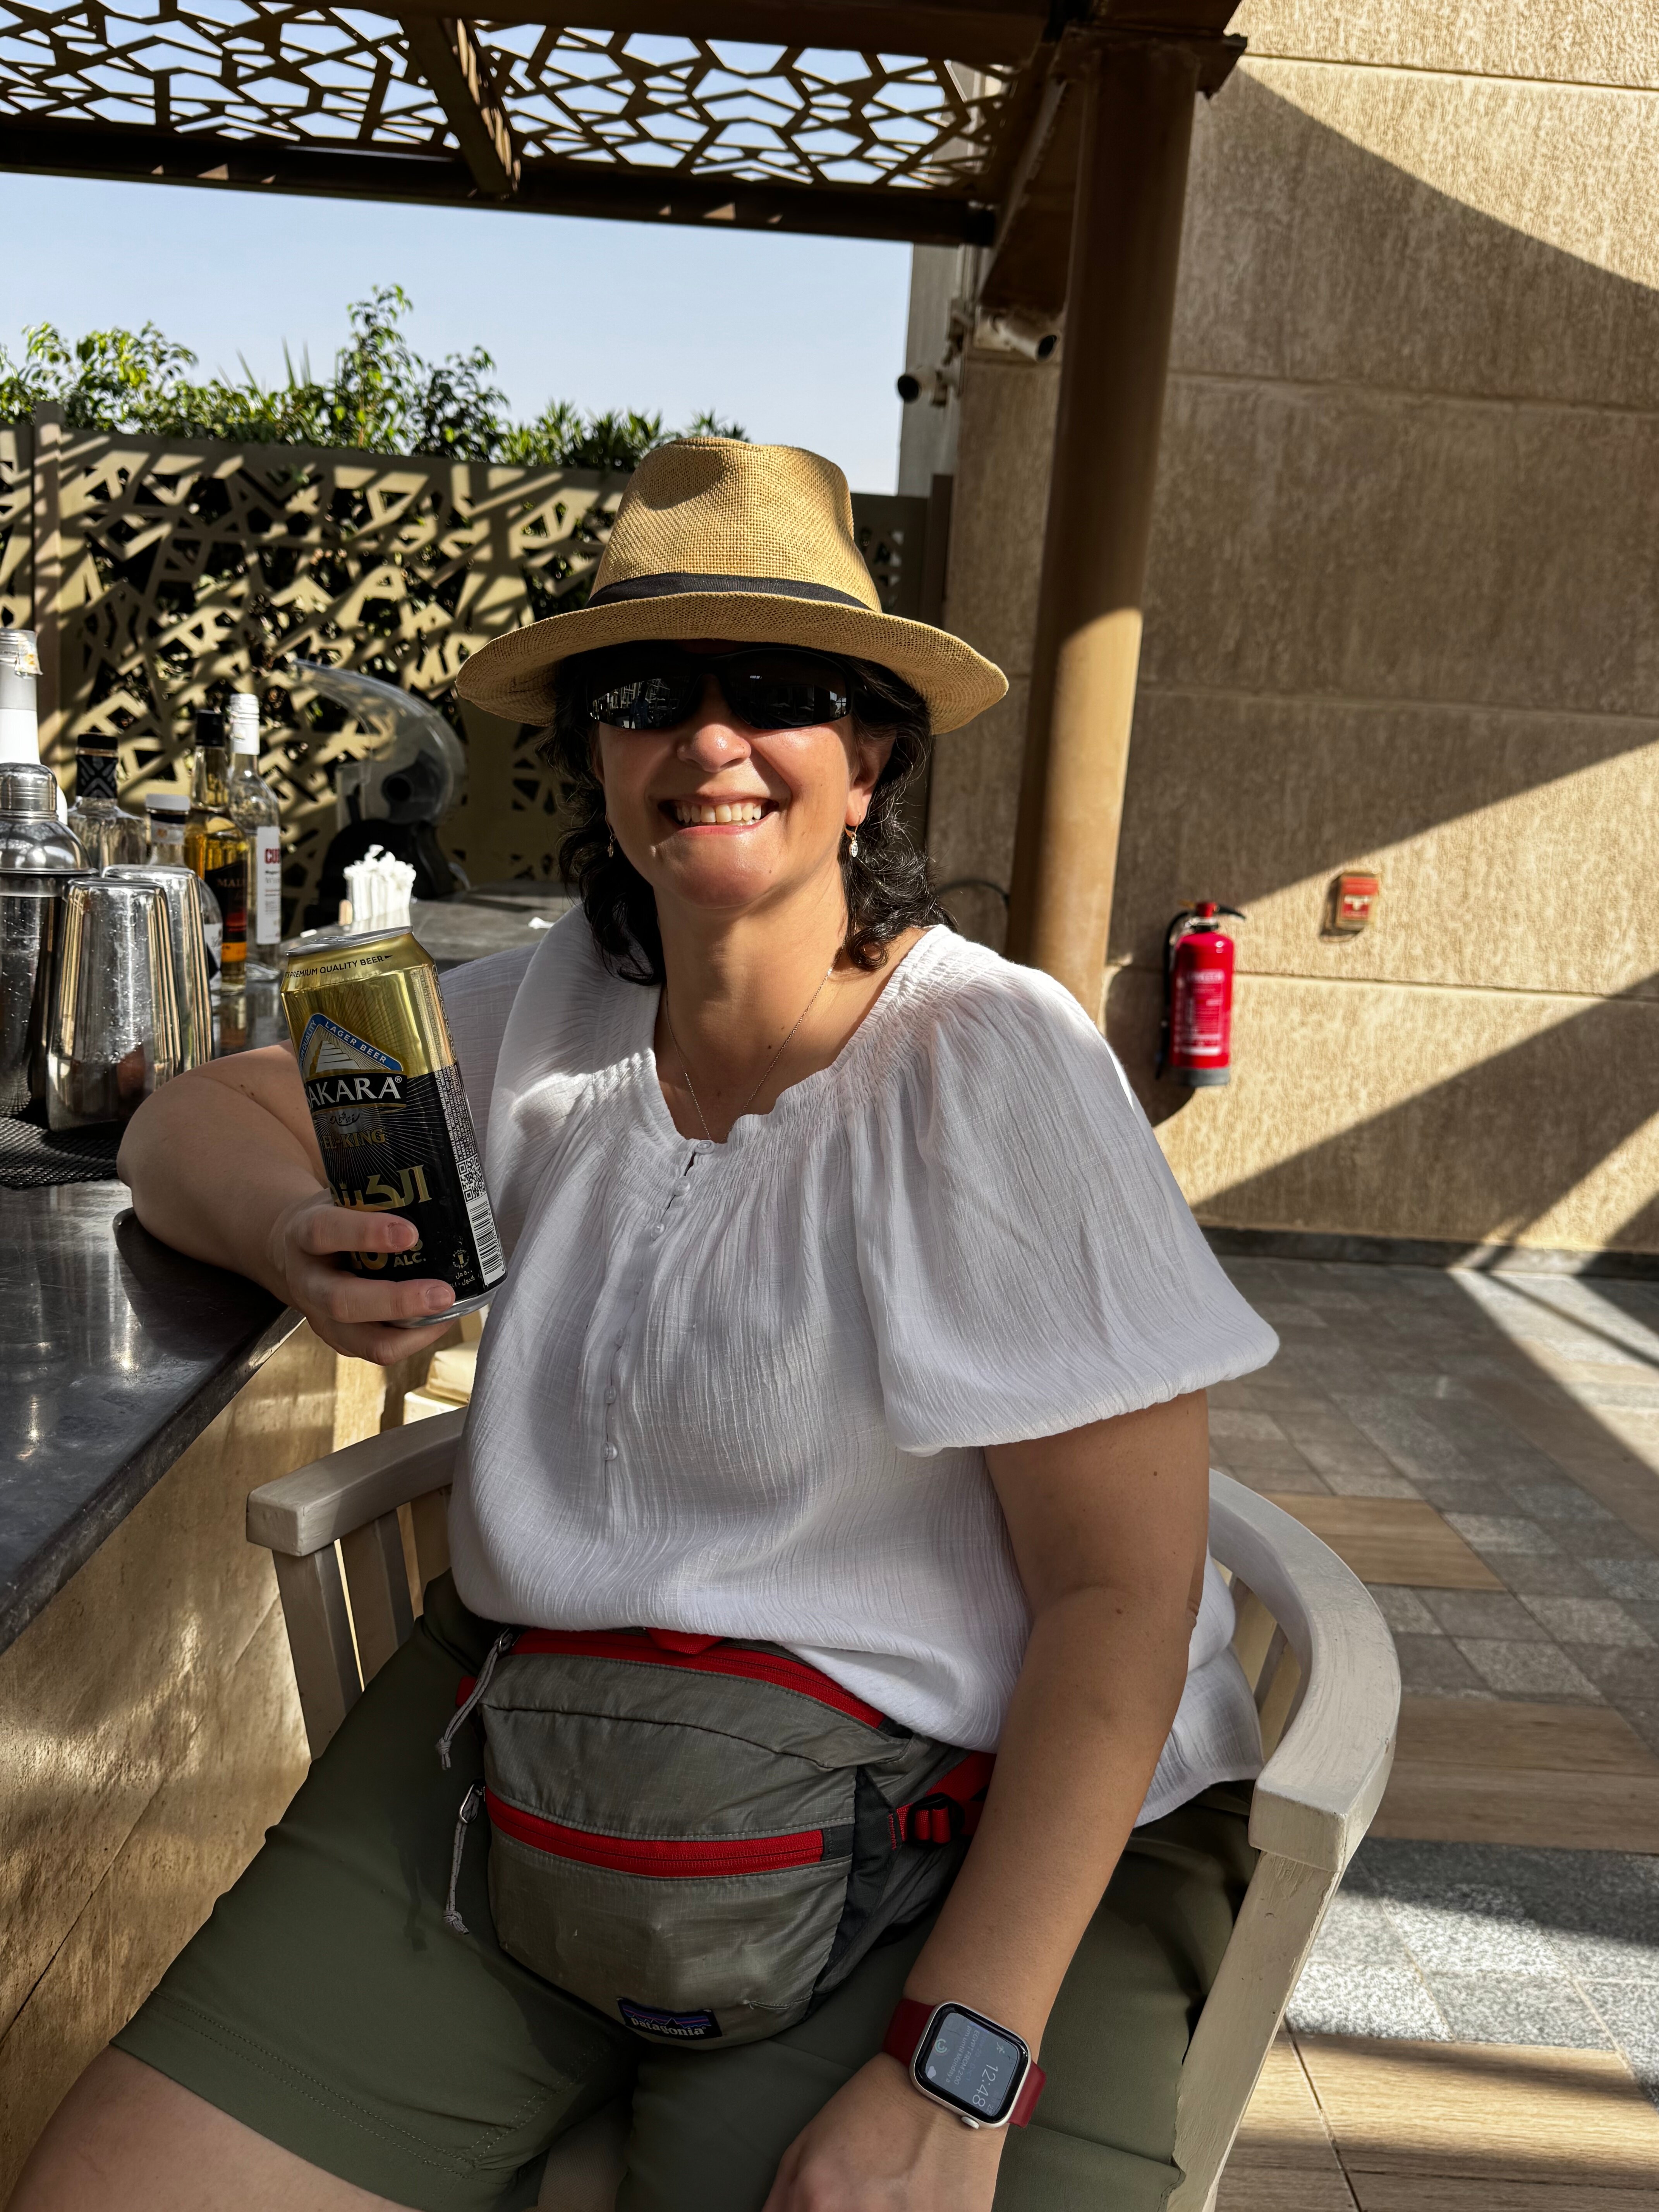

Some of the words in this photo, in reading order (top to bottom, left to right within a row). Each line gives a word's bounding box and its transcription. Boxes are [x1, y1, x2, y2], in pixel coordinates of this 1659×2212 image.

[290, 968, 318, 978] PREMIUM
[320, 960, 357, 974] QUALITY
[360, 955, 383, 966] BEER
[302, 1020, 316, 1050] QUALITY
[325, 1021, 357, 1046] LAGER
[359, 1044, 387, 1063] BEER
[307, 1077, 401, 1109] AKARA
[322, 1128, 385, 1149] EL-KING
[394, 1252, 426, 1267] ALC.
[630, 2017, 704, 2036] patagonia
[965, 2025, 972, 2037] pm
[958, 2037, 967, 2053] until
[968, 2030, 980, 2051] EGYPT
[947, 2052, 962, 2078] Monday
[961, 2051, 972, 2070] FROM
[972, 2064, 998, 2107] 12:48
